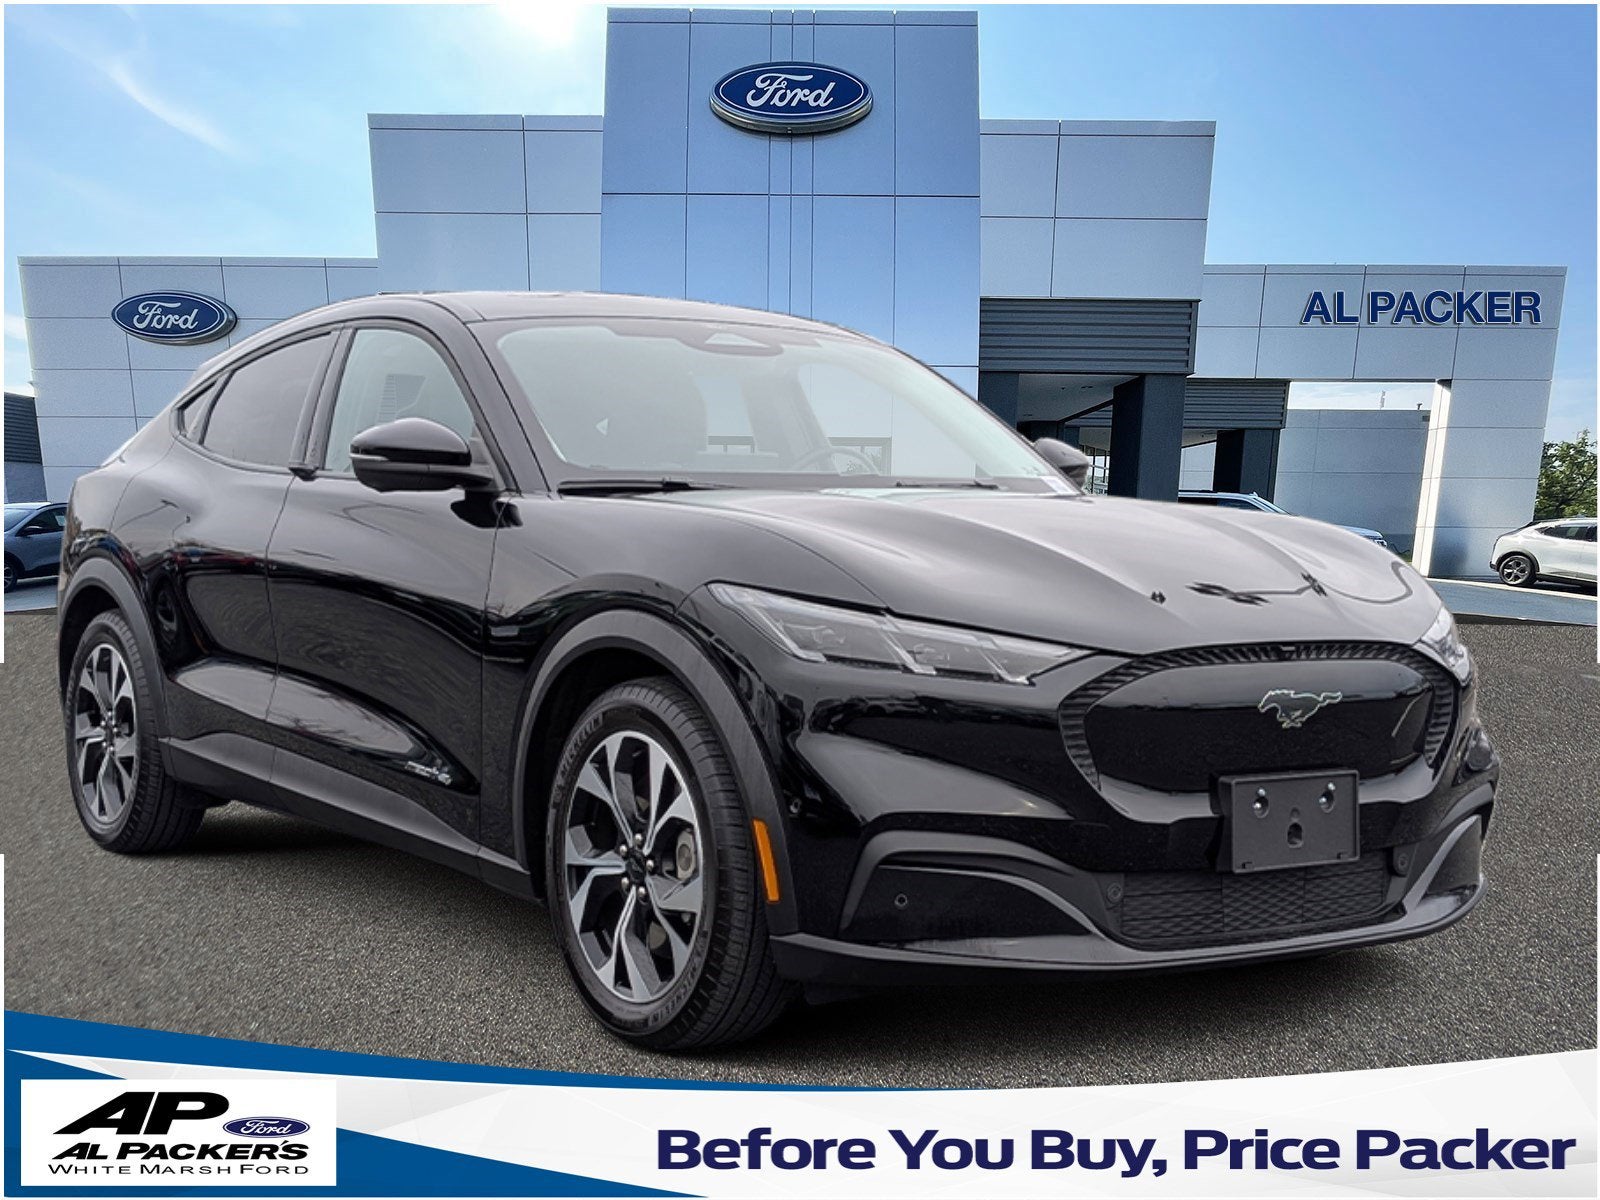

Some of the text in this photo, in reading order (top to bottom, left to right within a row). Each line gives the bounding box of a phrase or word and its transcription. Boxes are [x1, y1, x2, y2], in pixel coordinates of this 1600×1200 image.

[746, 73, 836, 107] Ford
[133, 301, 198, 329] Ford
[1302, 290, 1542, 324] AL PACKER
